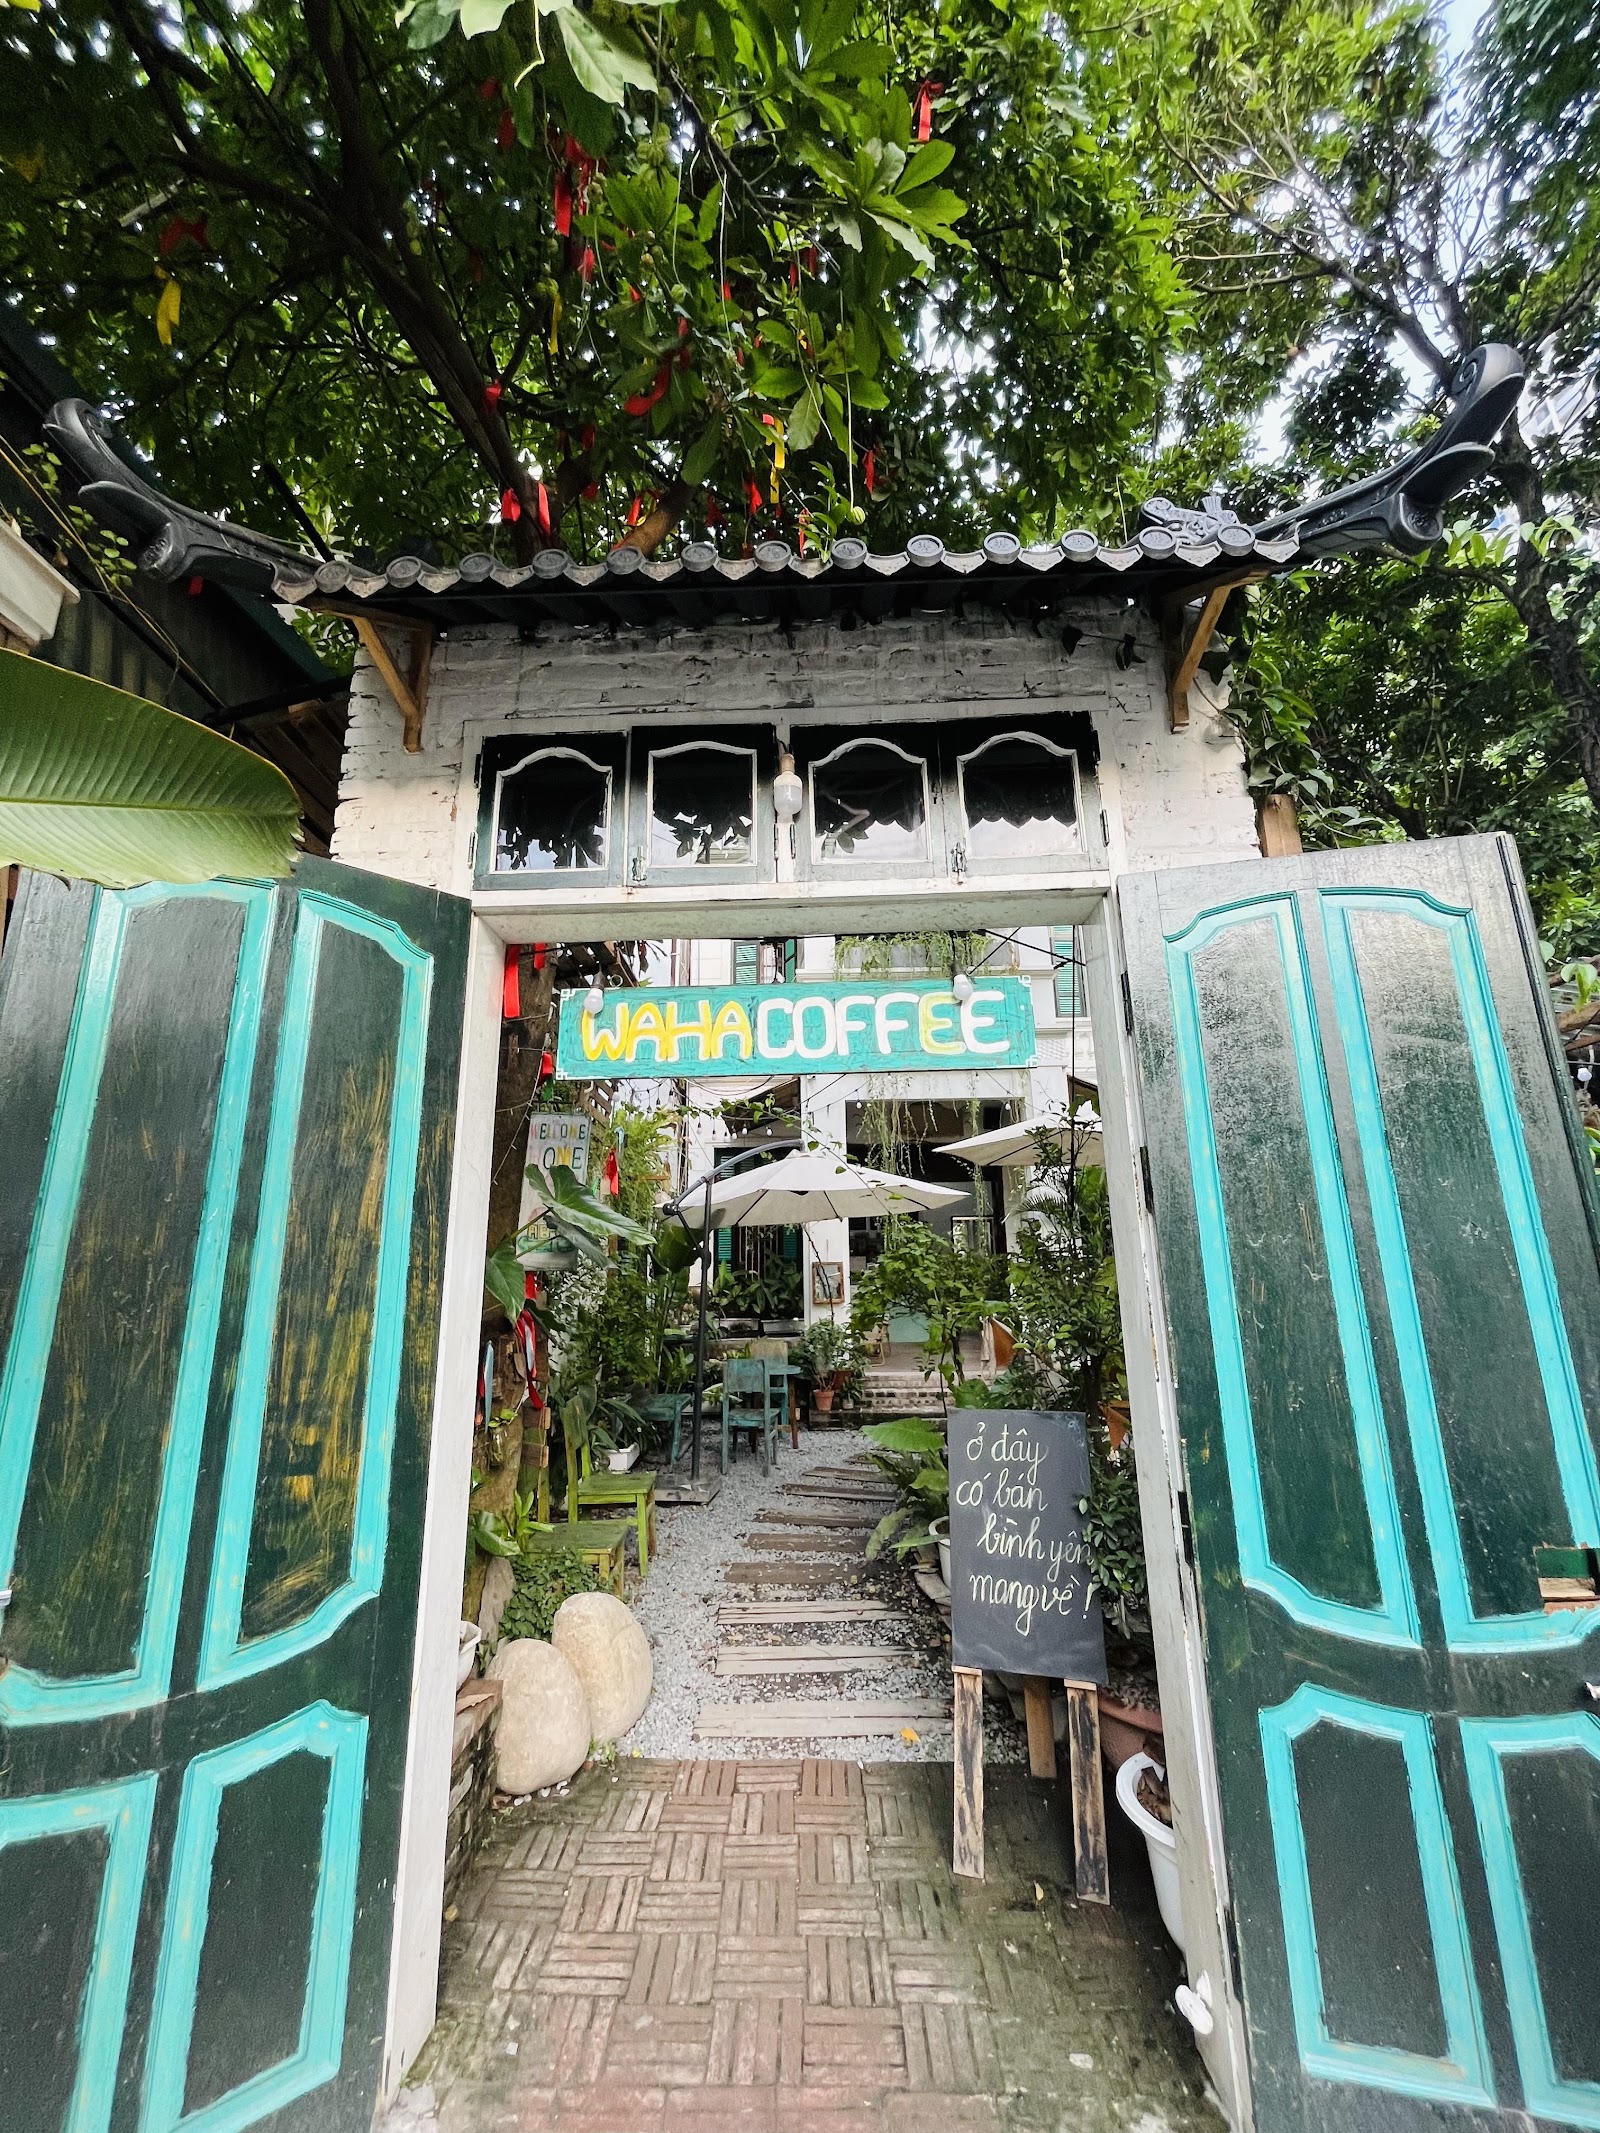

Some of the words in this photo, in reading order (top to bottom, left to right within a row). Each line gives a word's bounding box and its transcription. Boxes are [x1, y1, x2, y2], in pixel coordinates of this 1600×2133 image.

[582, 1001, 753, 1062] WAHA
[757, 991, 1010, 1059] COFFEE
[990, 1424, 1046, 1485] đây
[956, 1472, 992, 1507] có
[992, 1467, 1049, 1512] bán
